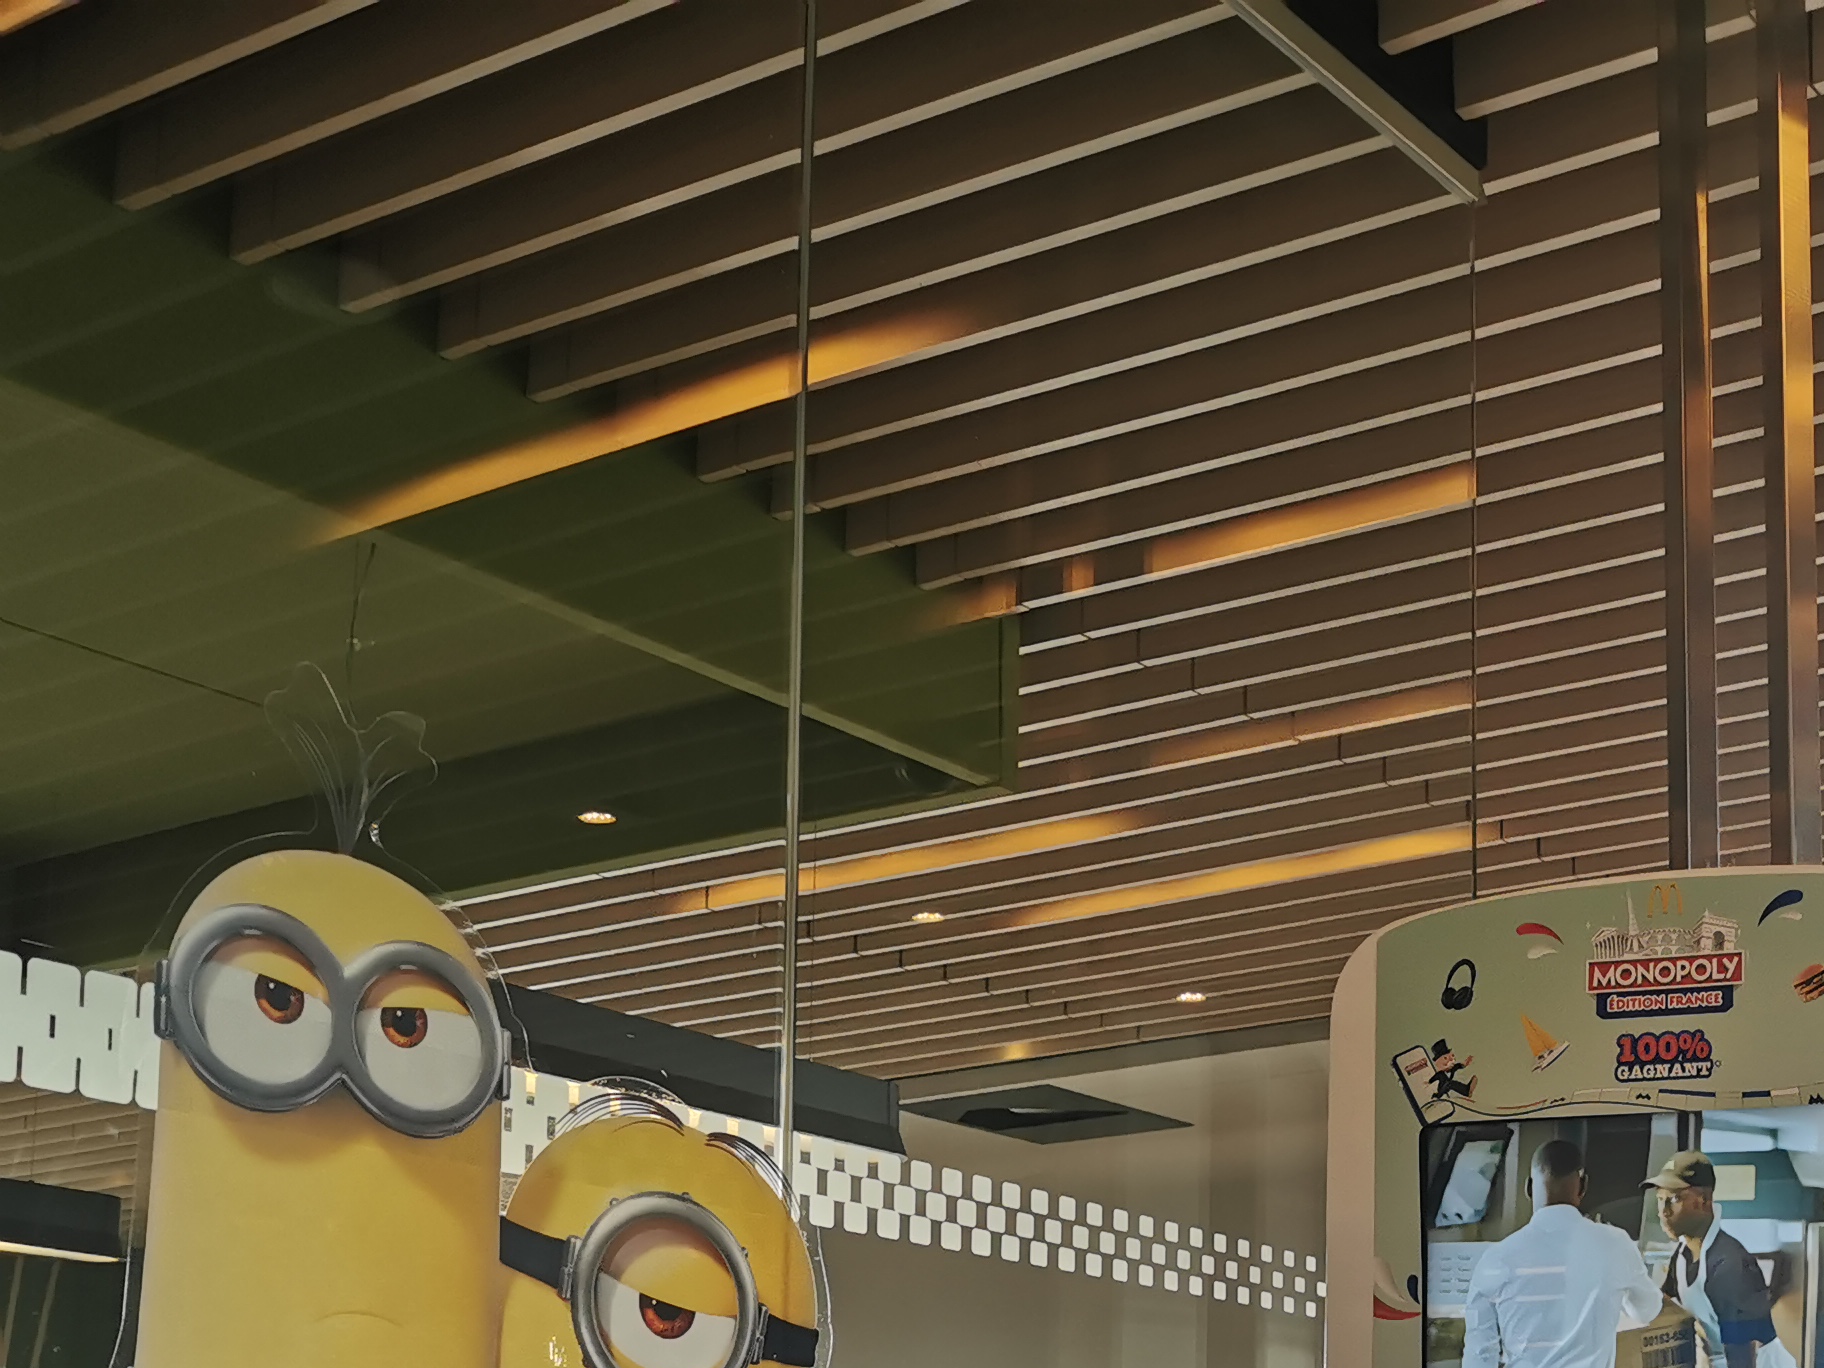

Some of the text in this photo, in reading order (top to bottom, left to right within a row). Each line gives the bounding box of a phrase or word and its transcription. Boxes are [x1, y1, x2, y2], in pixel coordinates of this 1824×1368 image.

[1592, 955, 1739, 988] MONOPOLY
[1607, 991, 1723, 1013] ÉDITION FRANCE
[1618, 1030, 1711, 1063] 100%
[1616, 1060, 1712, 1080] GAGNANT
